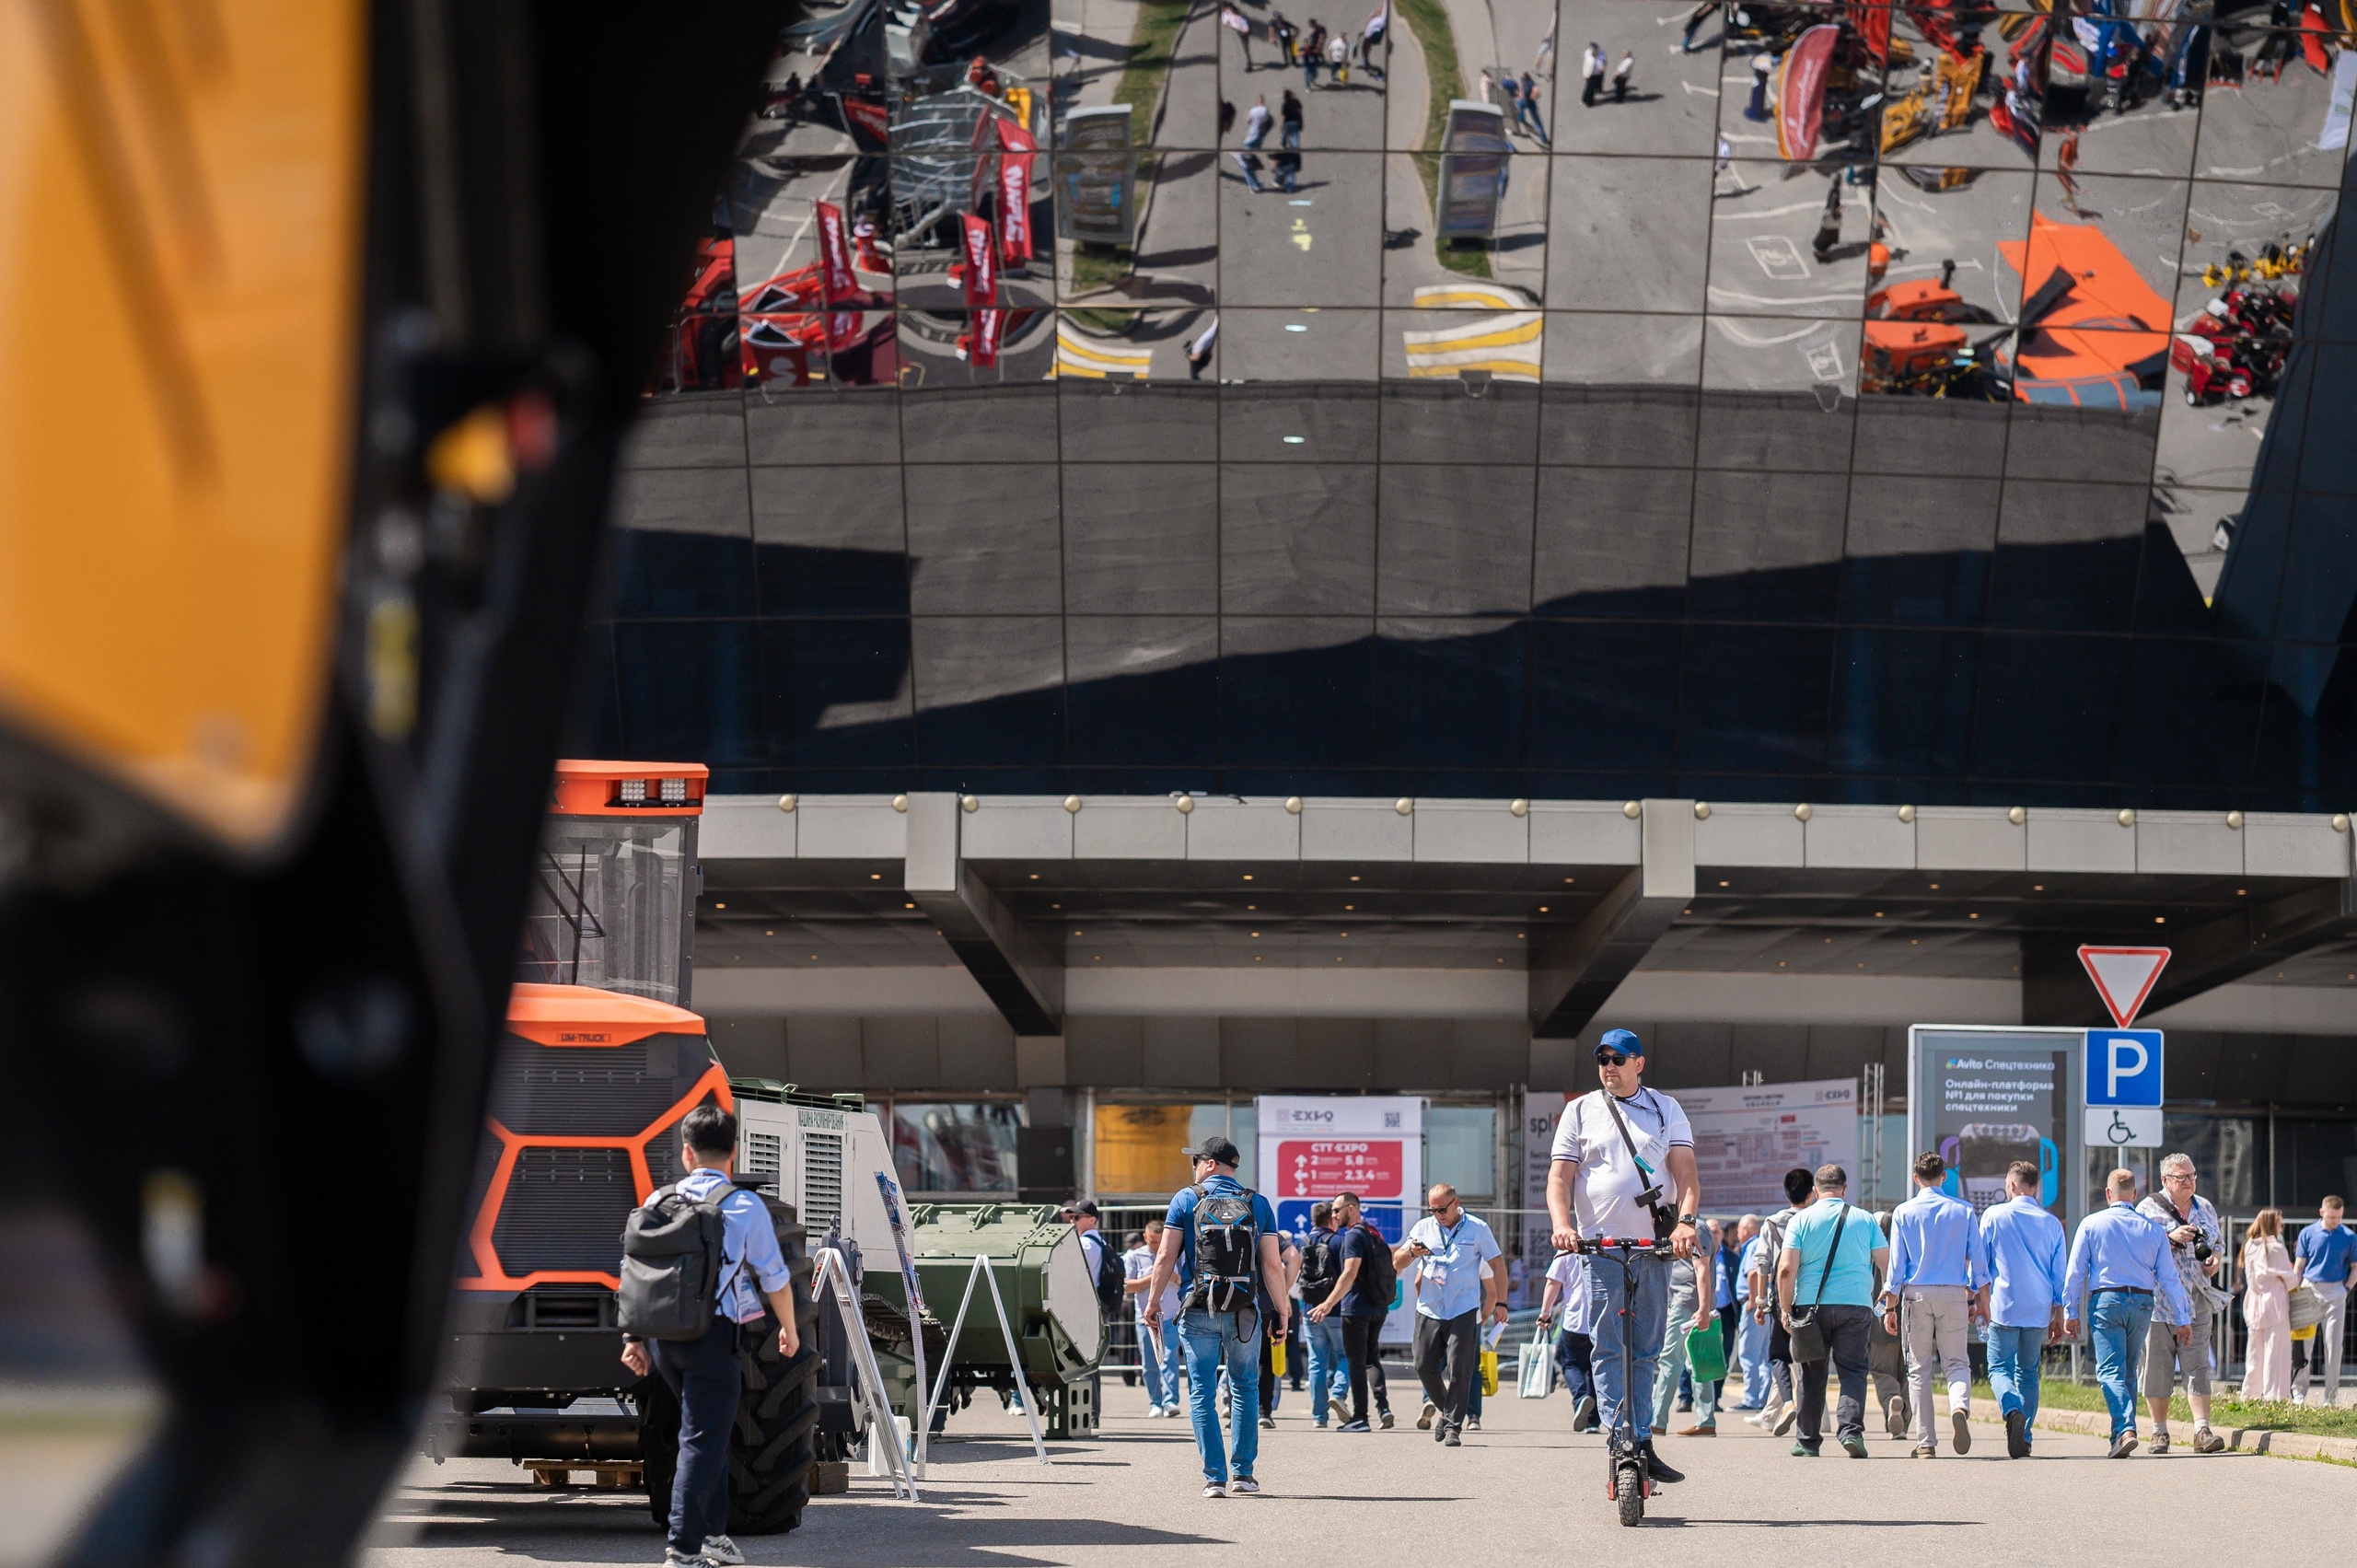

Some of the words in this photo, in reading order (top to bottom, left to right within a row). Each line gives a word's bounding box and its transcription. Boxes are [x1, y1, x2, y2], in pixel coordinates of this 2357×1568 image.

[1956, 1059, 1983, 1069] Avito
[1985, 1059, 2055, 1071] Спецтехника
[2107, 1039, 2149, 1098] P
[1945, 1078, 2054, 1092] Онлайн-платформа
[1965, 1092, 1986, 1101] для
[1988, 1093, 2034, 1103] покупки
[1945, 1103, 2017, 1113] спецтехники
[1311, 1143, 1333, 1153] CTT
[1334, 1143, 1368, 1153] EXPO
[1310, 1155, 1318, 1166] 2
[1310, 1169, 1318, 1180] 1
